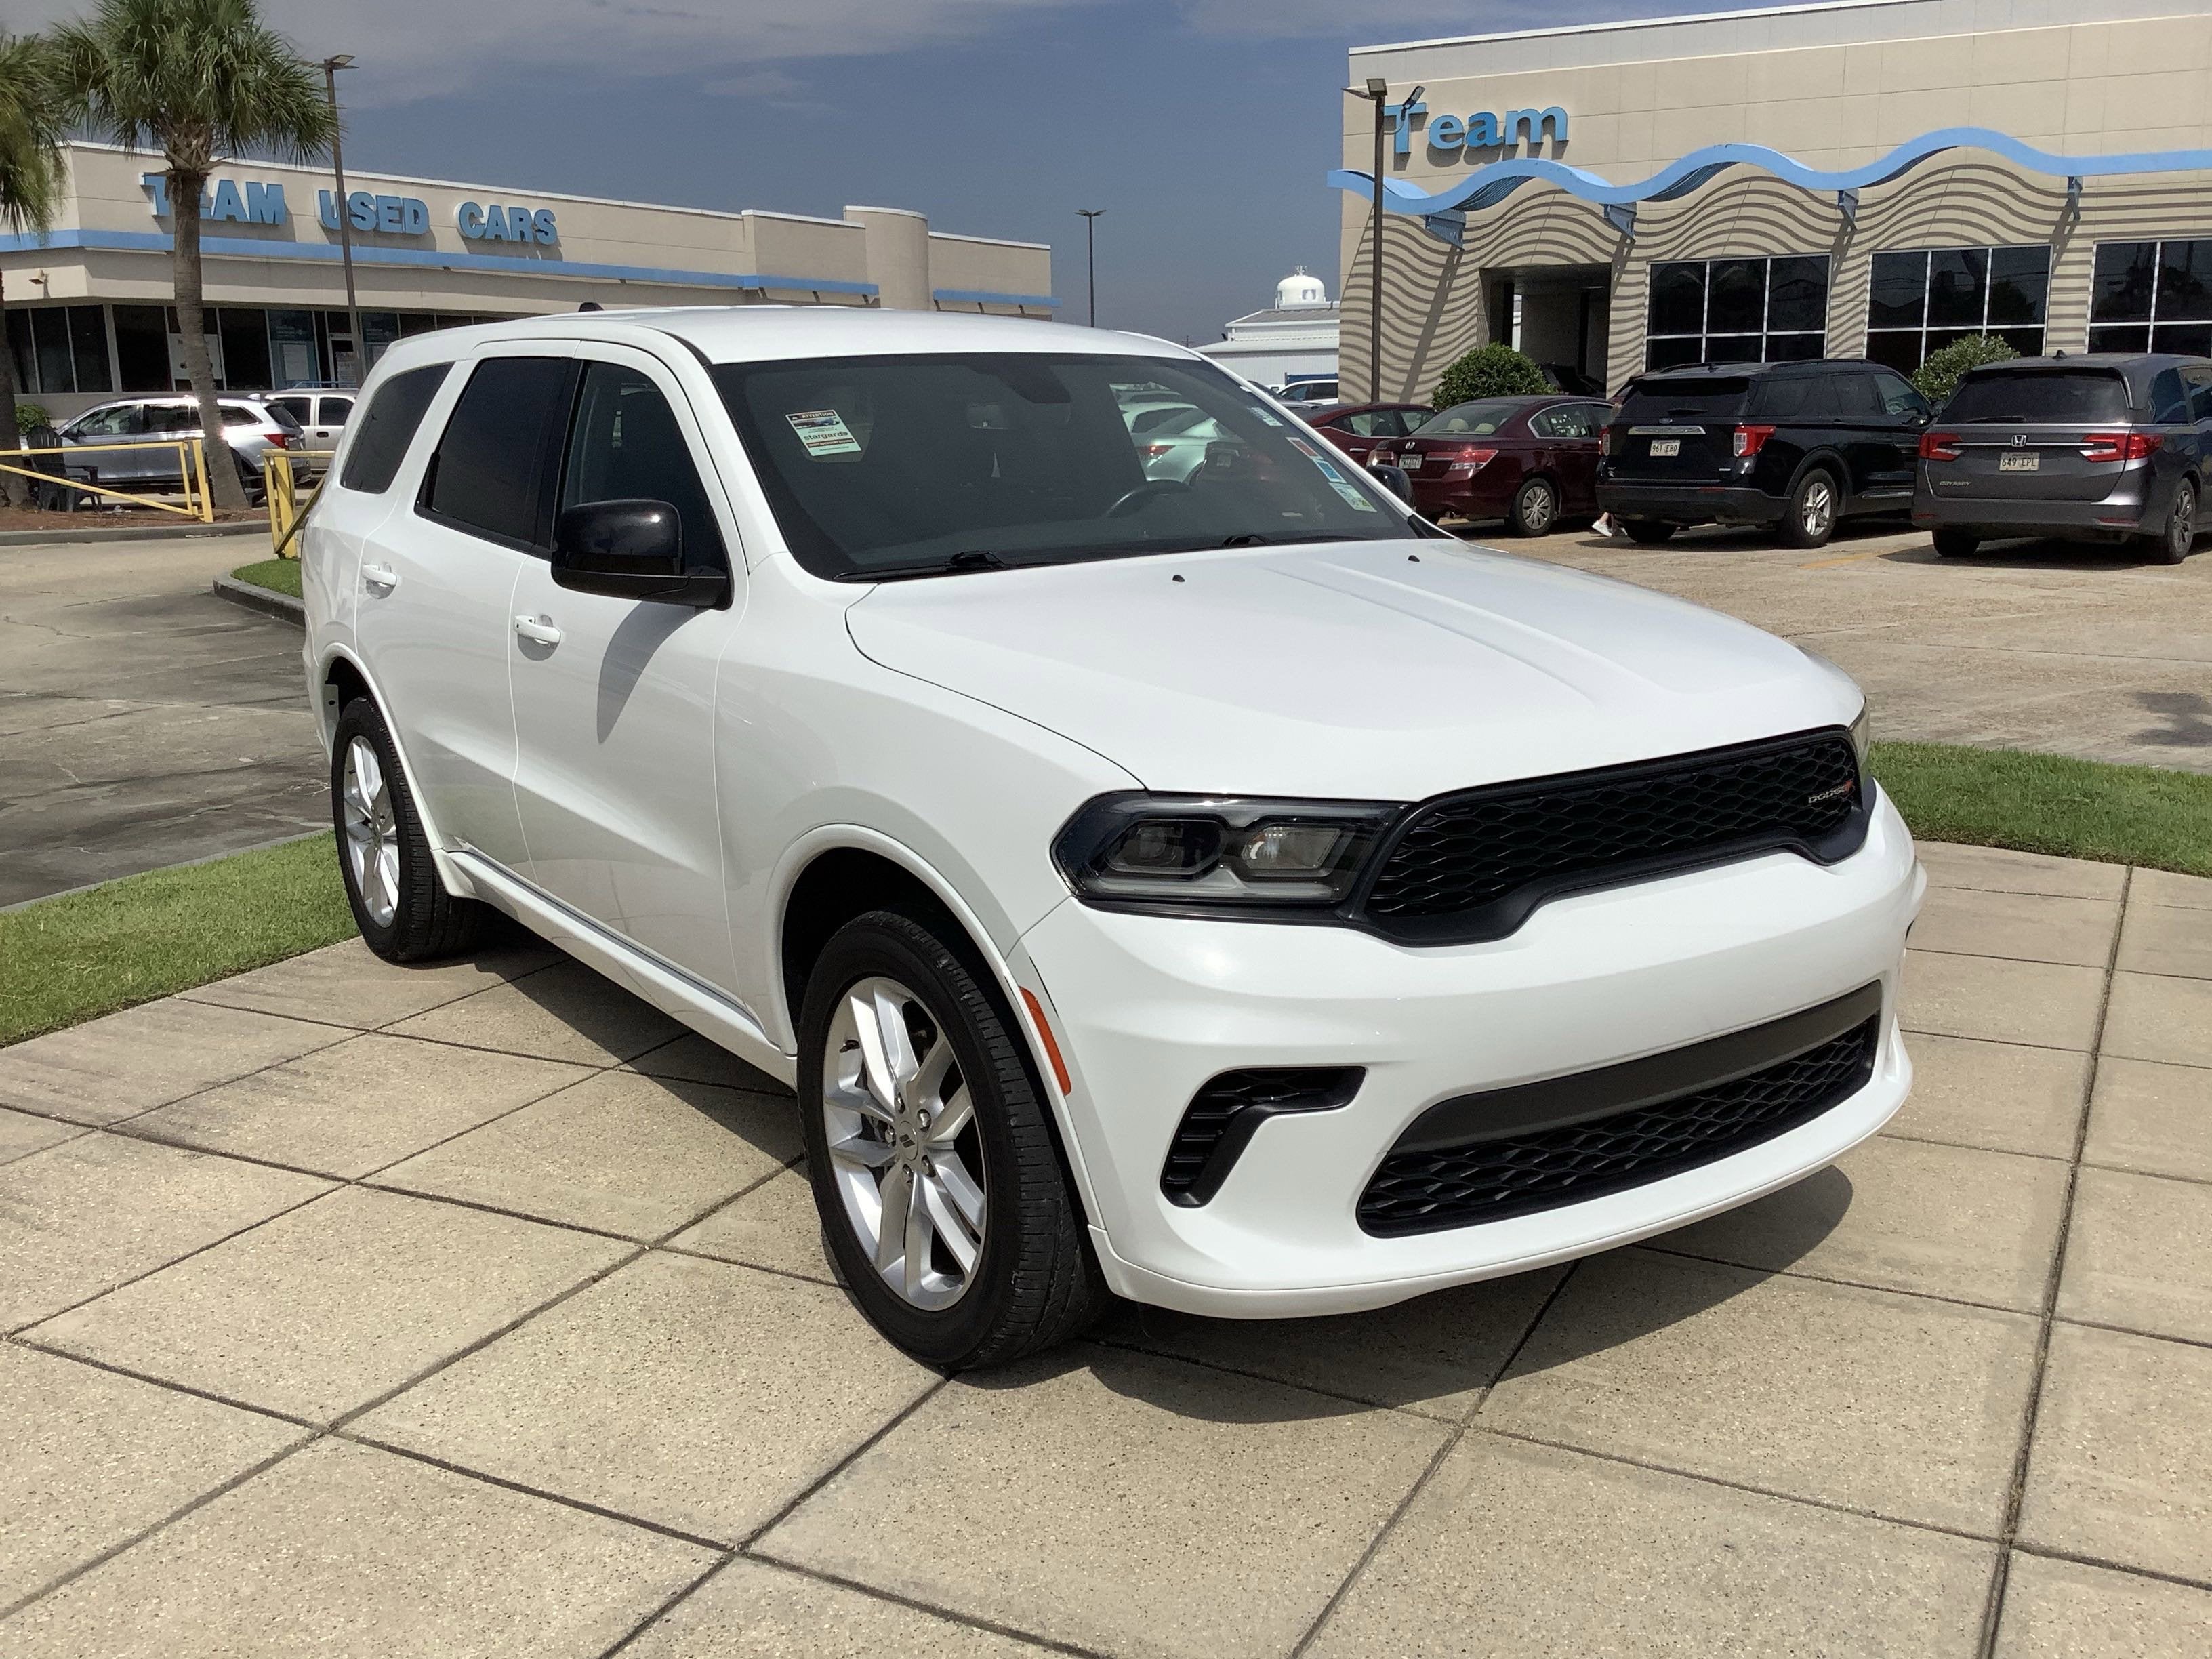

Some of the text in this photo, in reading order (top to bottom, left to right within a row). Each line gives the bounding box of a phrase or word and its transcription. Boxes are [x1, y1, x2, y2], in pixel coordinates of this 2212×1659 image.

[1383, 102, 1568, 154] Team
[139, 172, 558, 245] TAM USED CARS
[1652, 444, 1662, 453] 961
[2002, 457, 2036, 467] 649 EPL
[1808, 784, 1847, 804] DODGE
